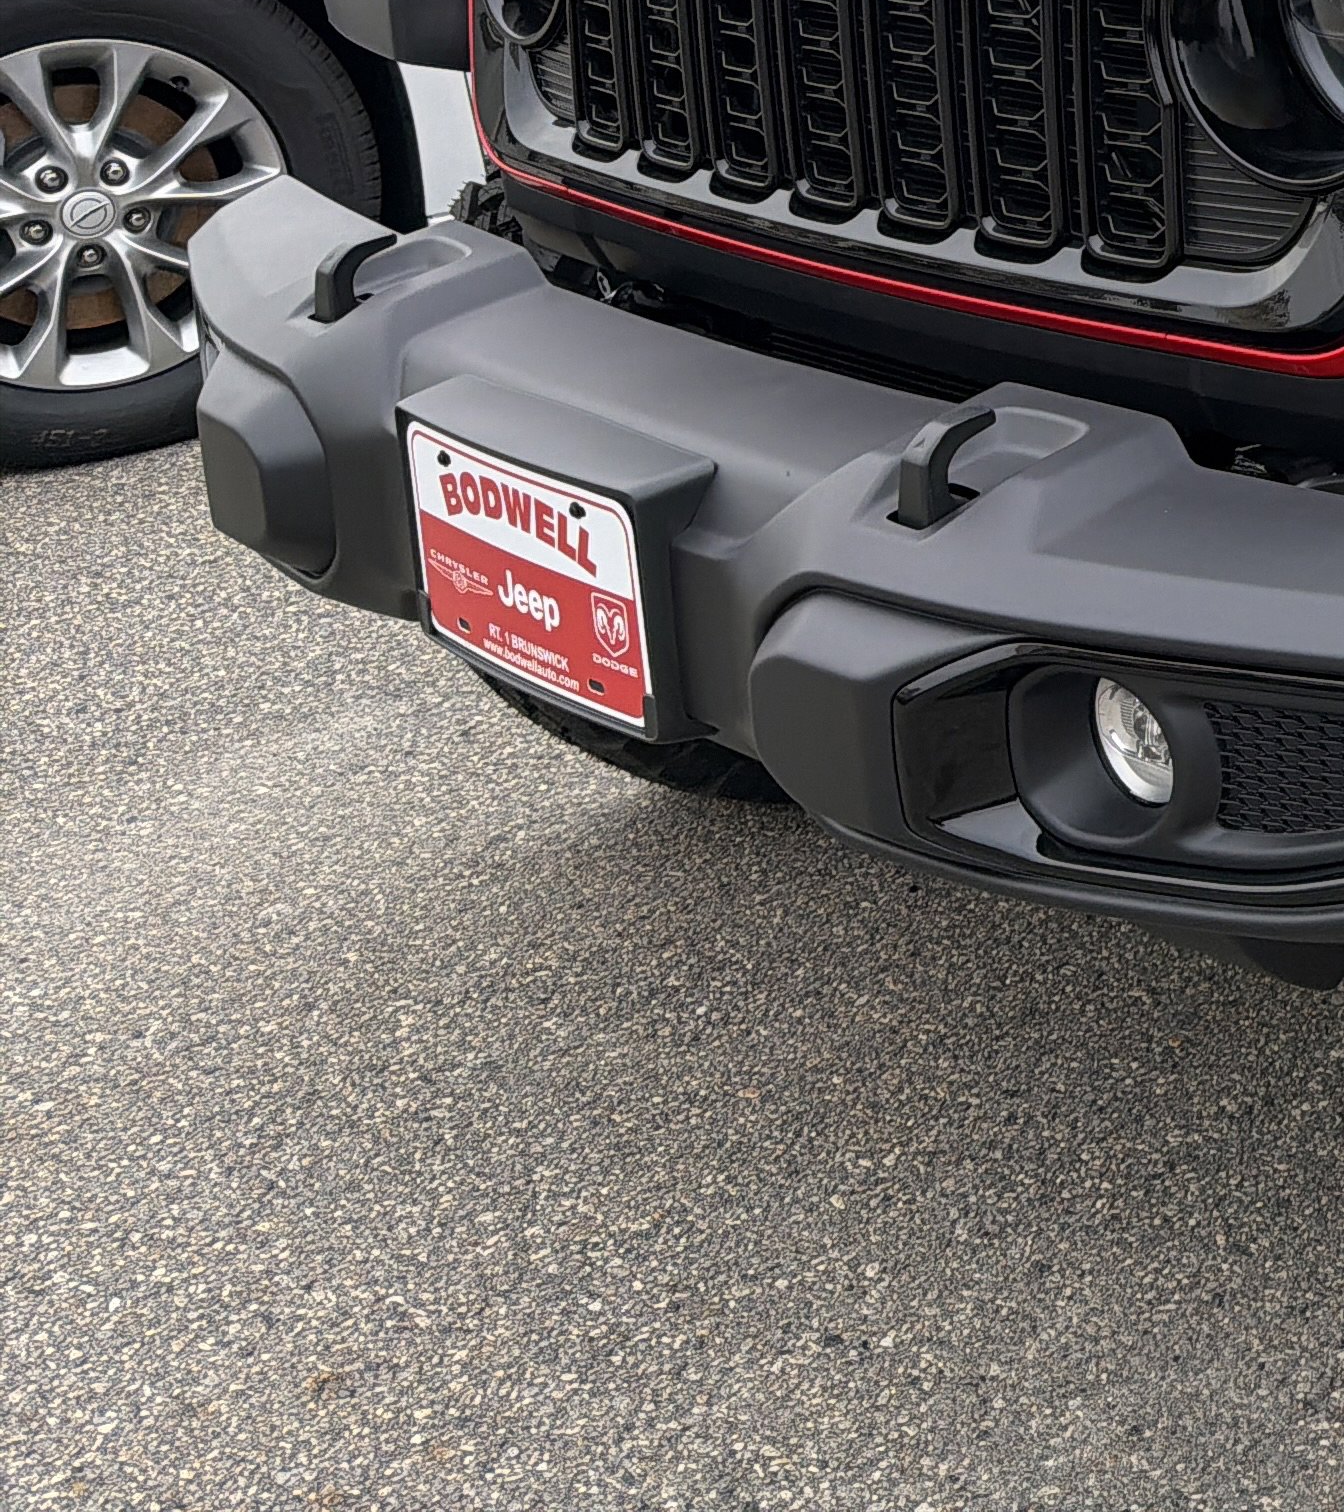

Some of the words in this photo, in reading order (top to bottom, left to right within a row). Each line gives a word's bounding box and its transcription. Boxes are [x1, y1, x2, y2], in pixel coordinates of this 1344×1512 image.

[438, 471, 598, 578] BODWELL
[429, 548, 489, 585] CHRYSLER
[497, 569, 560, 631] Jeep
[483, 638, 580, 692] www.bodwellauto.com
[511, 631, 570, 672] BRUNSWICK
[592, 652, 639, 678] DODGE
